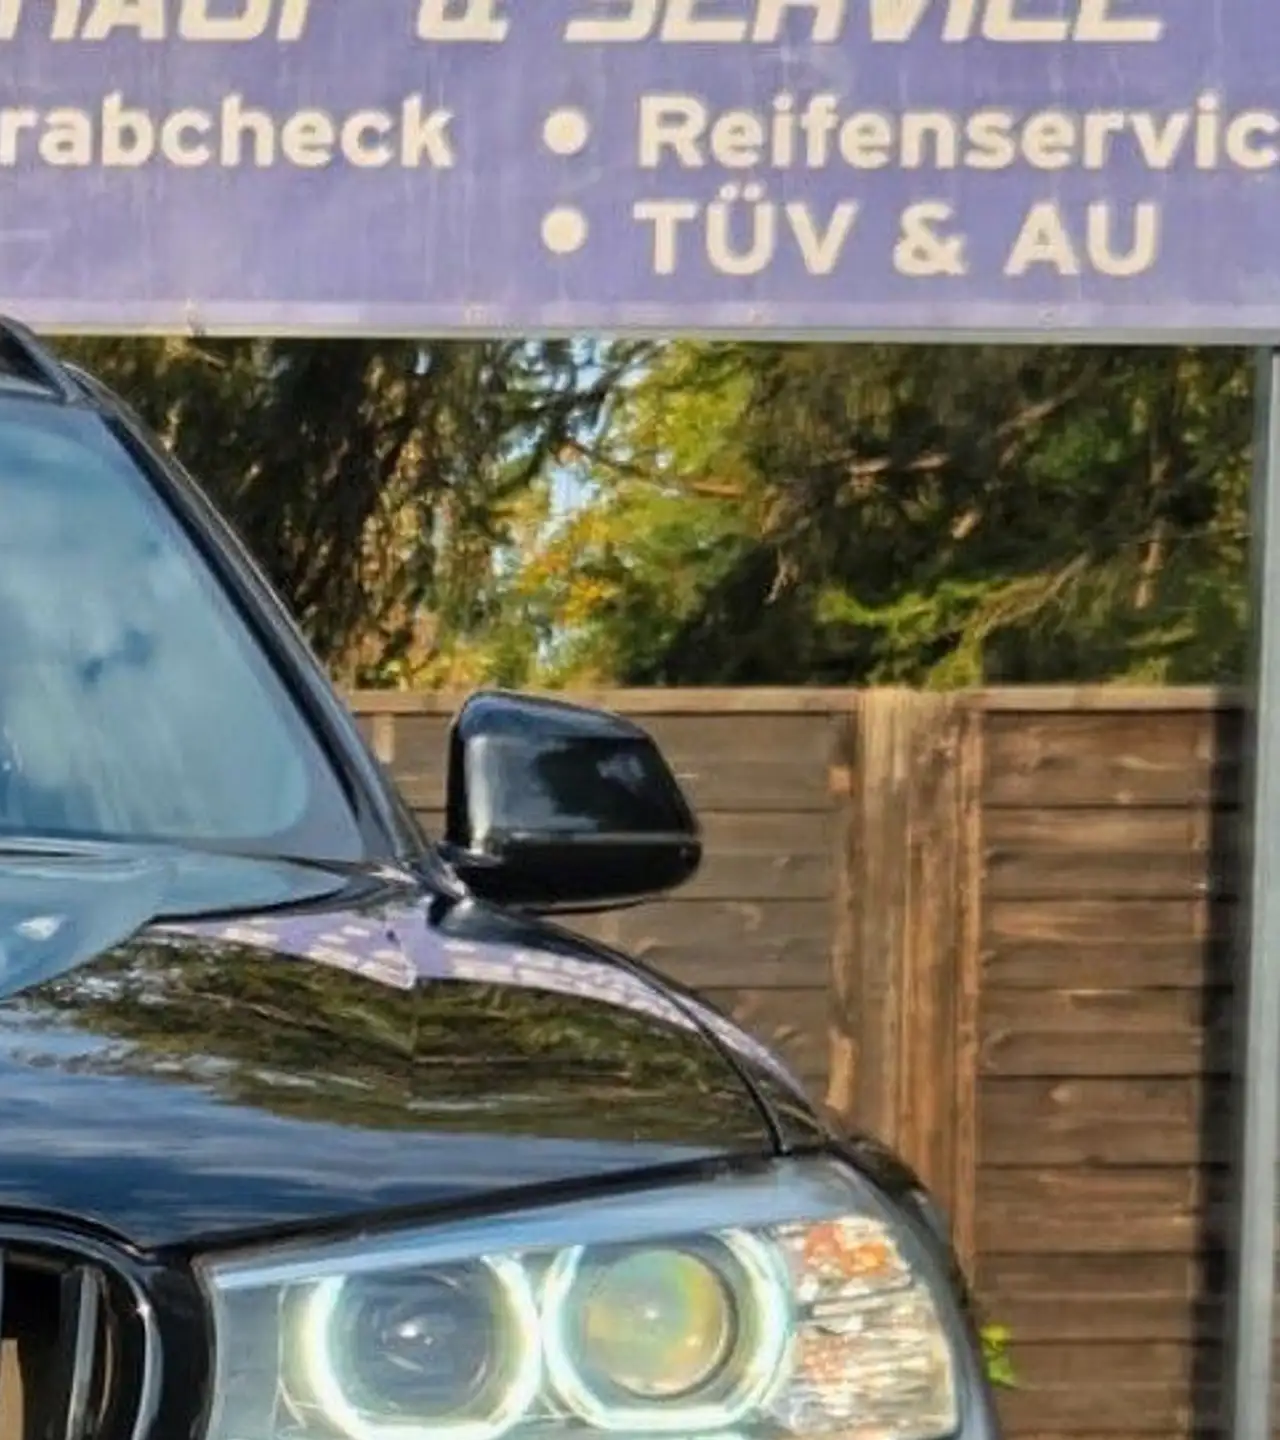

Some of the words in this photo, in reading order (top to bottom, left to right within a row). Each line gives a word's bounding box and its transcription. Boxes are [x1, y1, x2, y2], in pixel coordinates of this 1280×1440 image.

[638, 92, 1280, 172] Reifenservic
[634, 188, 856, 277] TÜV
[893, 203, 968, 277] &
[1005, 202, 1160, 278] AU
